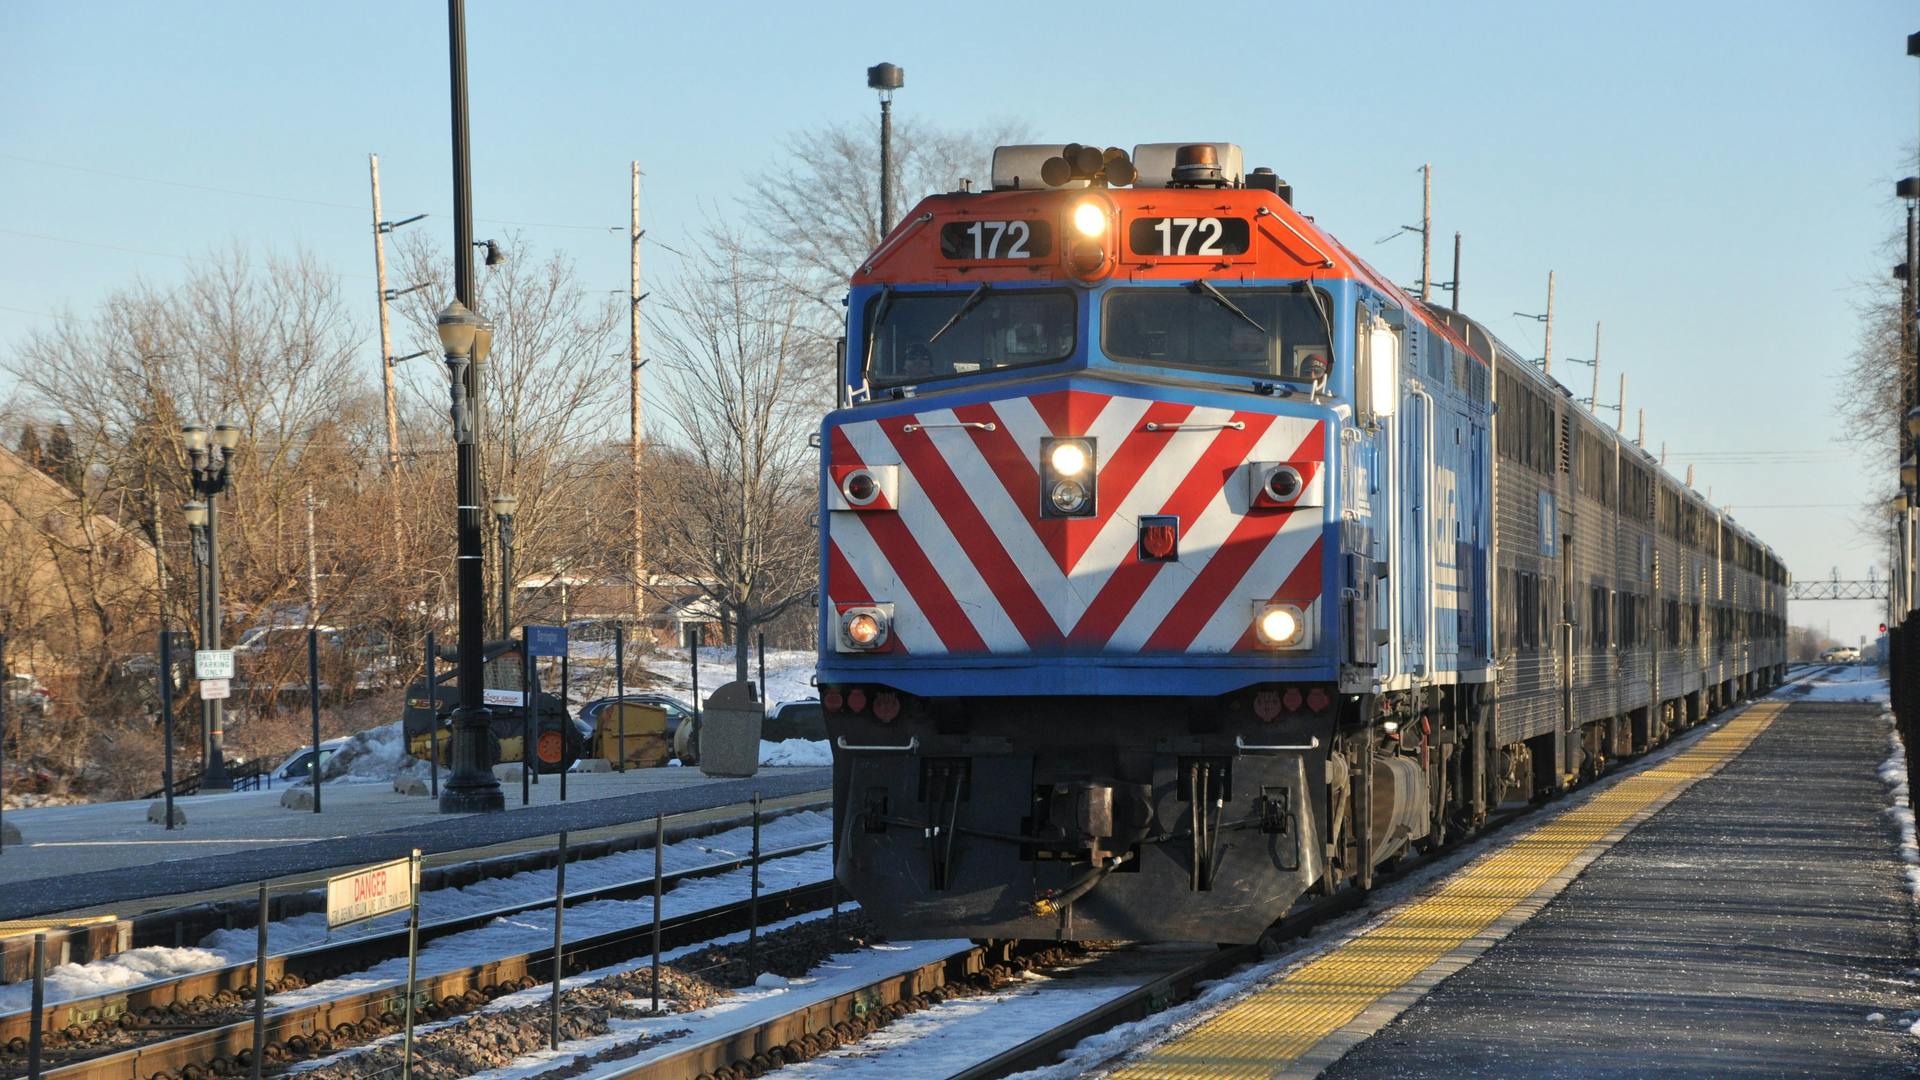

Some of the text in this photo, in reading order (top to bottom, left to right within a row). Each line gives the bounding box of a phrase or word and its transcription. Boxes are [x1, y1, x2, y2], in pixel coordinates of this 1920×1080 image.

[966, 220, 1030, 259] 172
[1154, 217, 1223, 256] 172
[219, 653, 230, 661] FEE
[354, 871, 387, 903] DANGER
